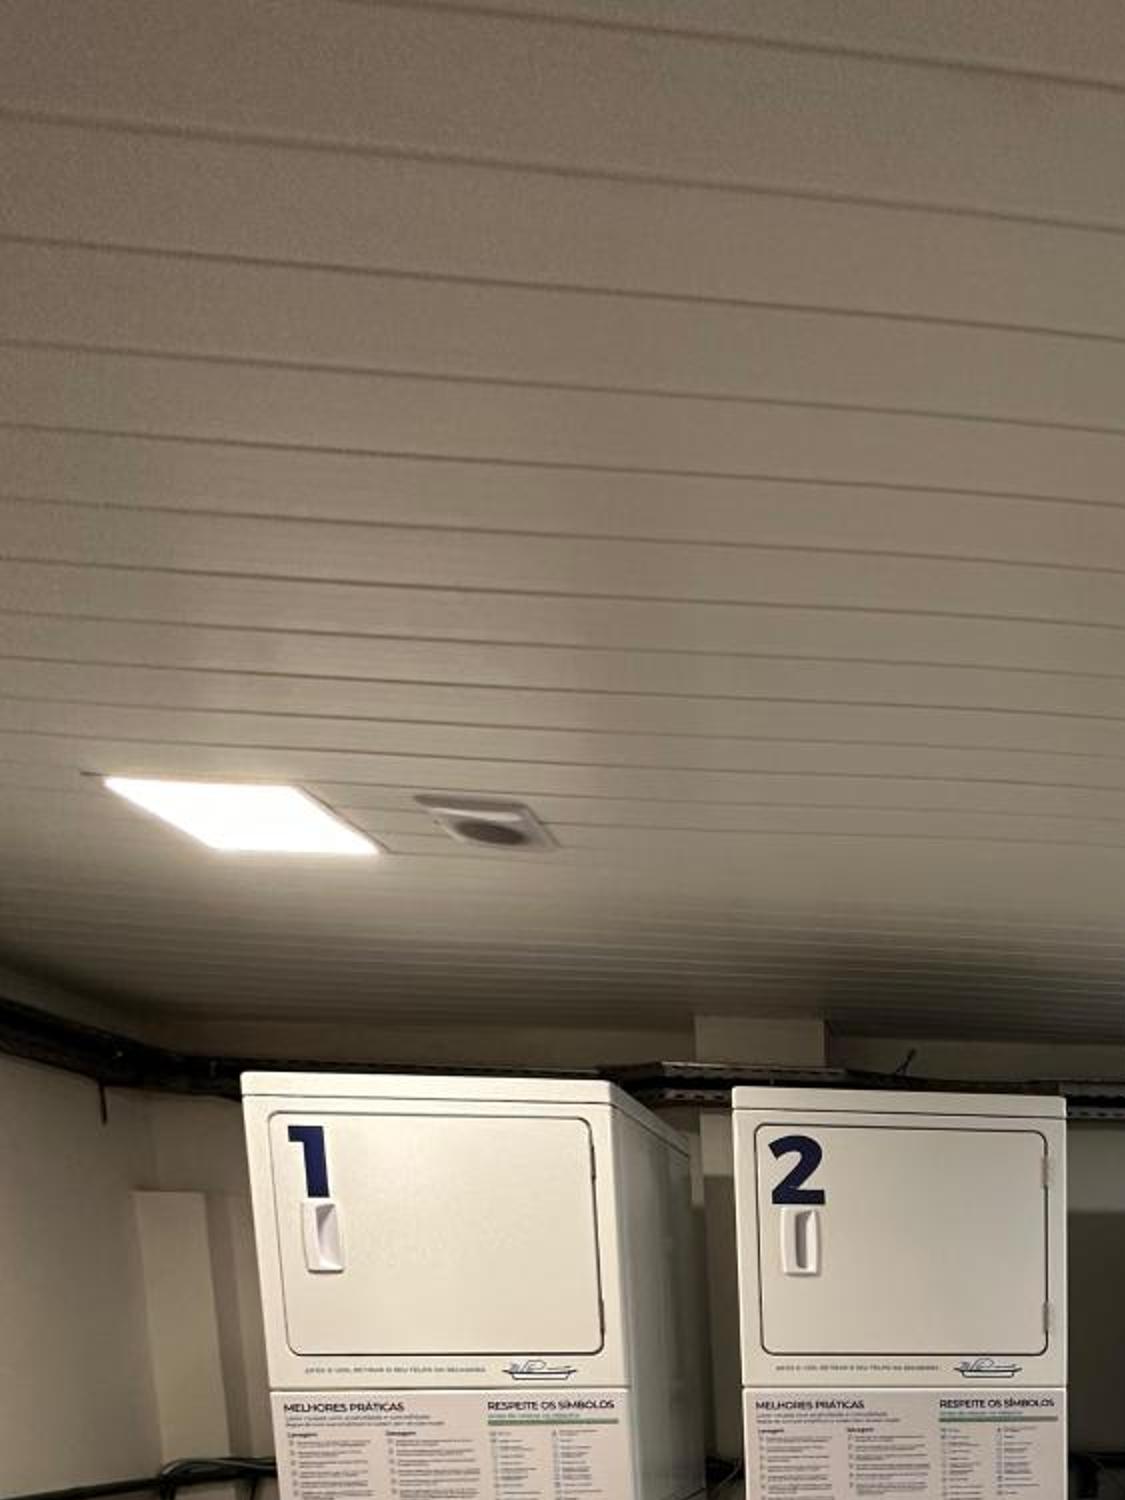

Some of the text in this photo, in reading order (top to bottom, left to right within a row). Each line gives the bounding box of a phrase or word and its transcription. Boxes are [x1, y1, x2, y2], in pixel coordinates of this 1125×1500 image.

[288, 1125, 329, 1198] 1
[768, 1135, 826, 1205] 2
[284, 1400, 405, 1414] MELHORES PRÁTICAS
[487, 1399, 615, 1411] RESPEITE OS SÍMBOLOS
[756, 1398, 865, 1410] MELHORES PRÁTICAS
[939, 1397, 1055, 1409] RESPEITE OS SÍMBOLOS
